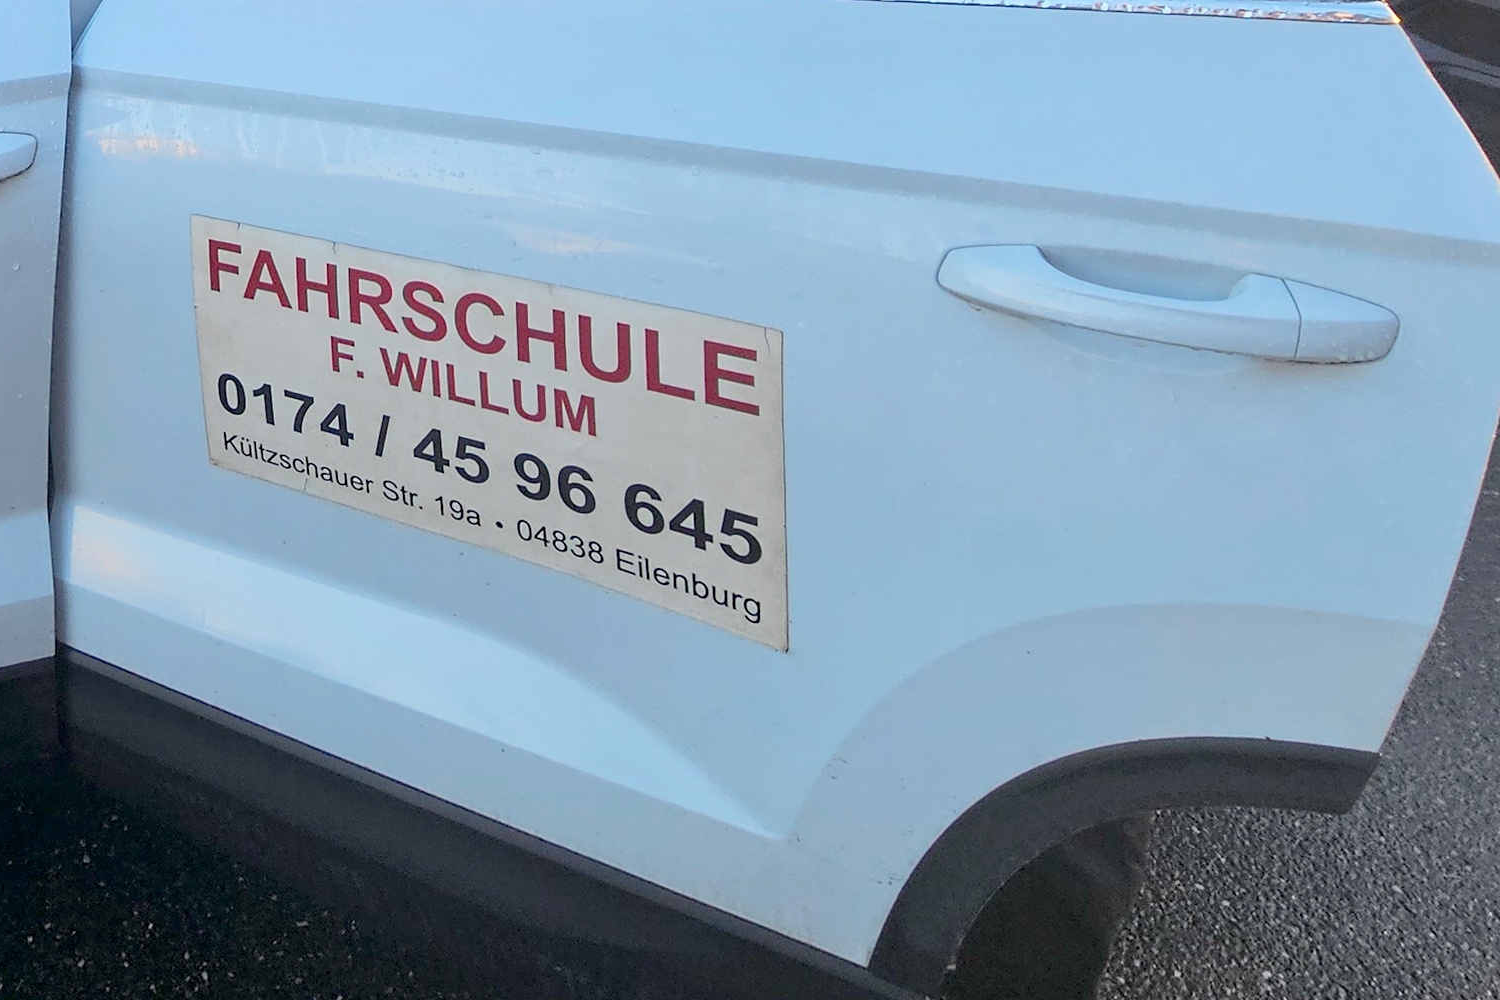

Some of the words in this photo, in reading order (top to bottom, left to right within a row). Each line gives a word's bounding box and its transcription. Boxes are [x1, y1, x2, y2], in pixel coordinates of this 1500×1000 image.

[208, 238, 760, 417] FAHRSCHULE
[330, 335, 365, 379] F.
[379, 347, 597, 437] WILLUM
[217, 373, 355, 448] 0174
[412, 428, 490, 484] 45
[513, 452, 597, 515] 96
[623, 483, 763, 565] 645
[223, 431, 374, 494] Kültzschauer
[382, 479, 424, 510] Str.
[434, 495, 482, 527] 19a
[516, 519, 605, 564] 04838
[615, 548, 762, 624] Eilenburg
